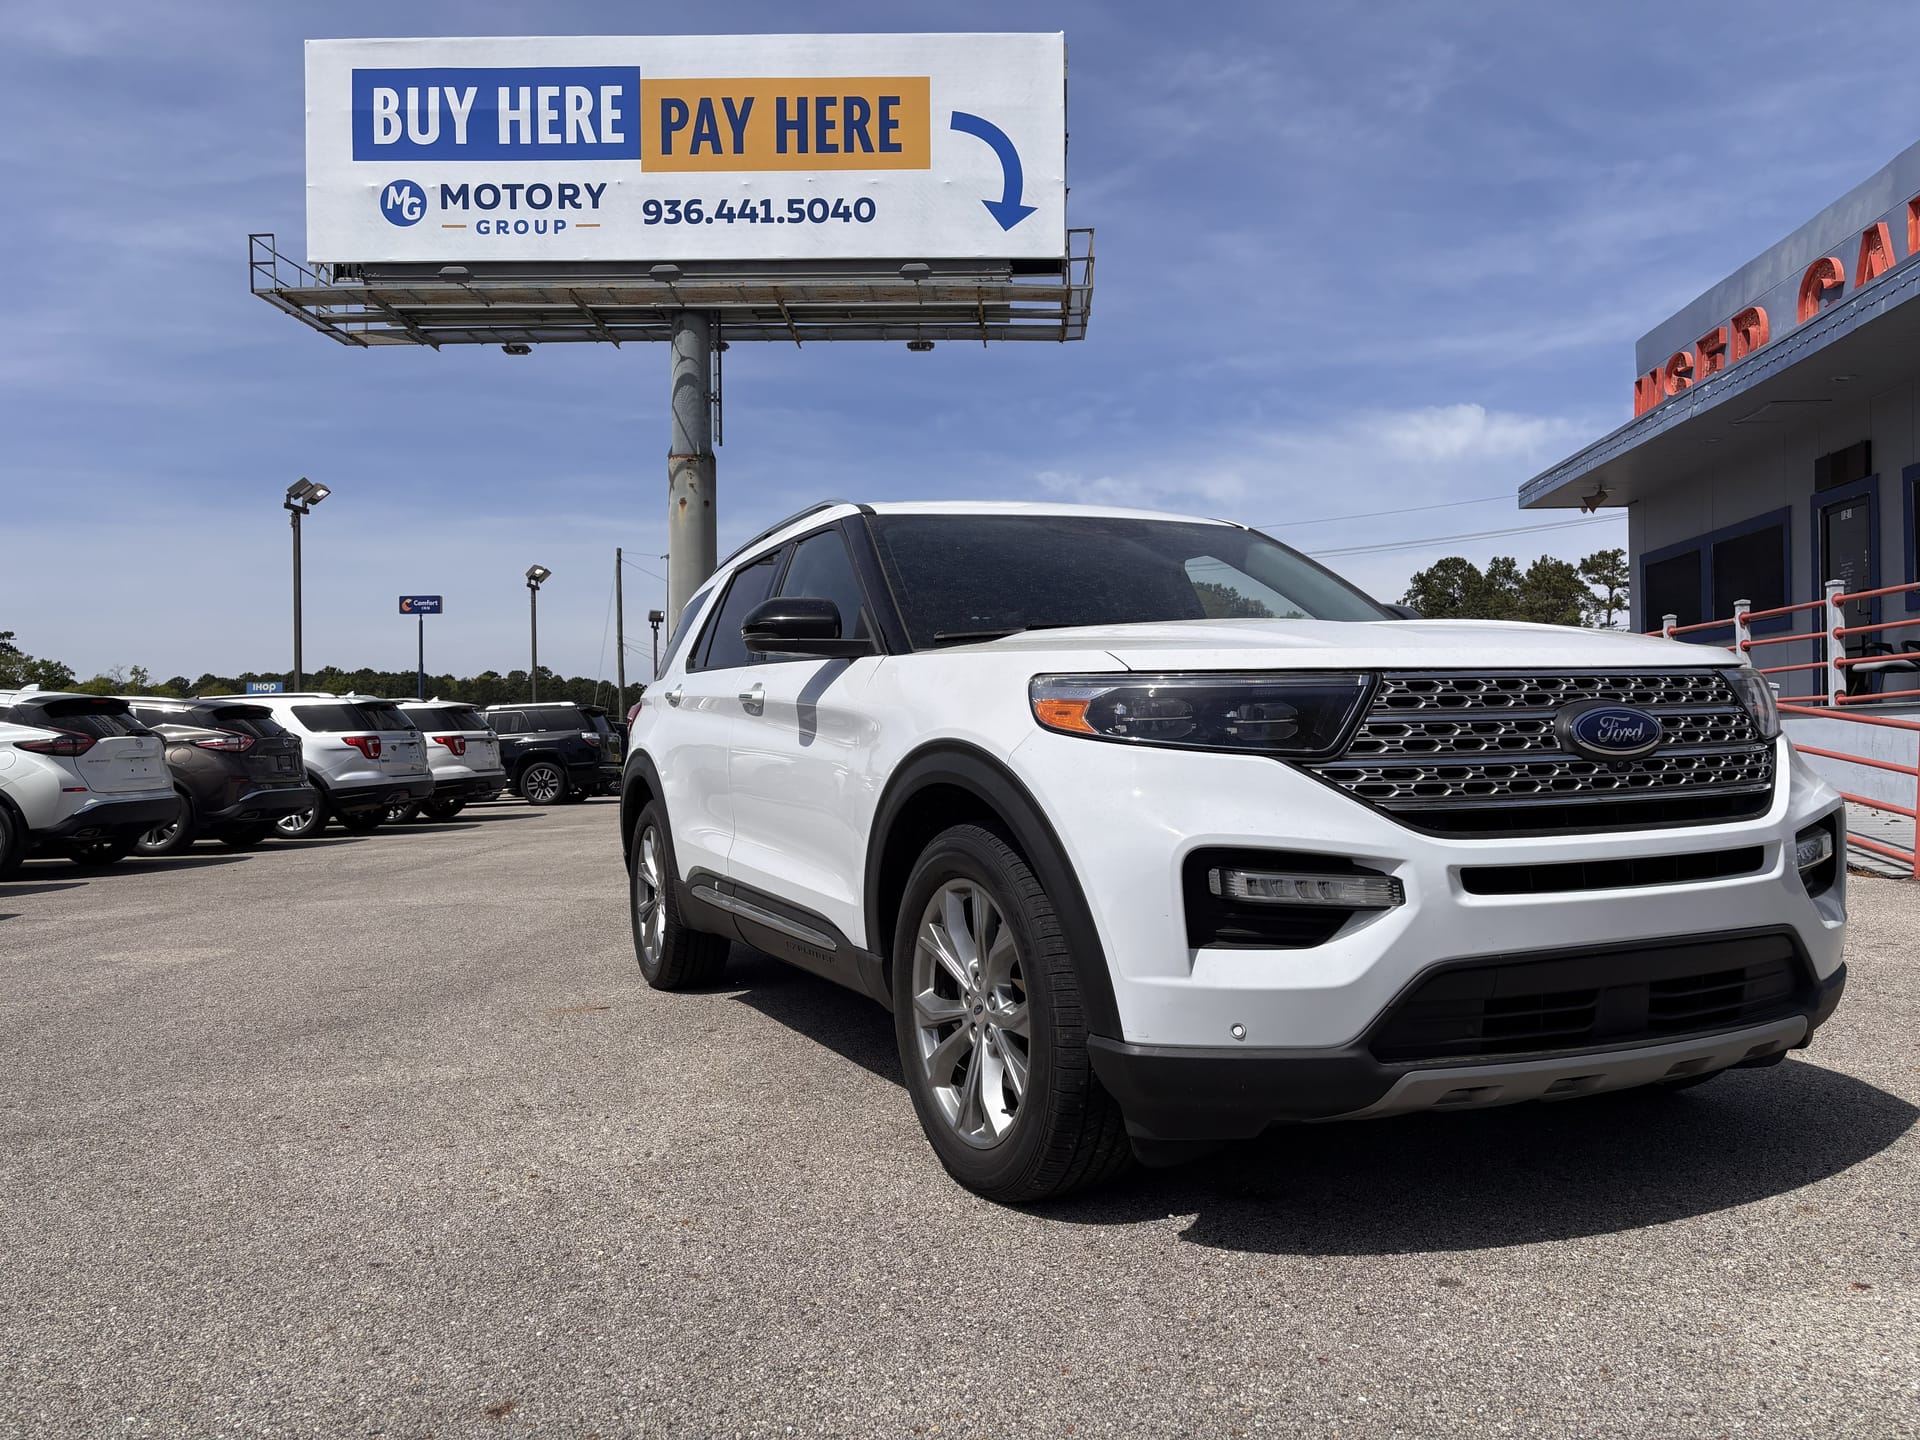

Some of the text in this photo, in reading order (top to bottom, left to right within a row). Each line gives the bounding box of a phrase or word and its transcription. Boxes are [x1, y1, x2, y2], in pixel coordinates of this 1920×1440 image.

[373, 86, 625, 146] BUY HERE
[661, 96, 903, 156] PAY HERE
[386, 185, 423, 221] MG
[440, 183, 607, 210] MOTORY
[642, 197, 876, 225] 936.441.5040
[476, 219, 567, 234] GROUP
[252, 683, 276, 693] IHOP
[1598, 716, 1645, 743] Ford
